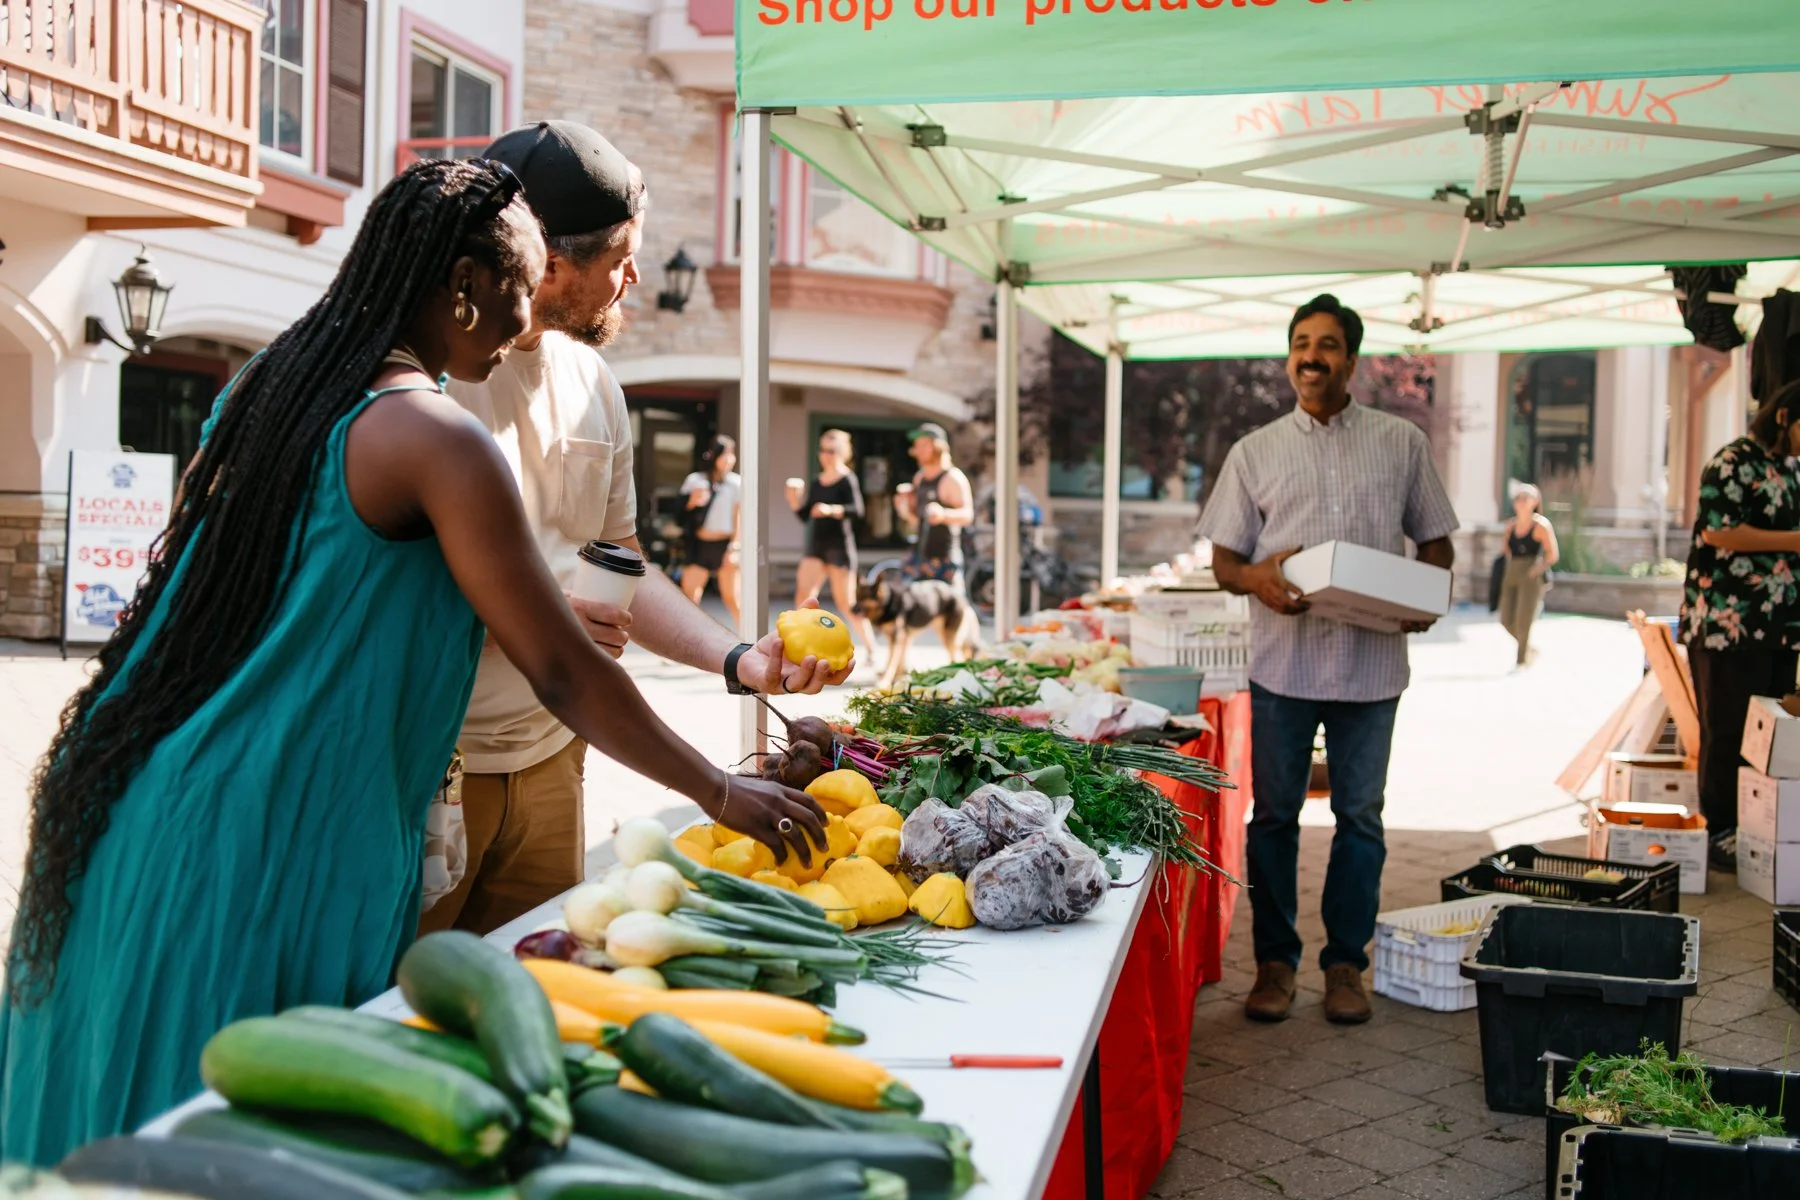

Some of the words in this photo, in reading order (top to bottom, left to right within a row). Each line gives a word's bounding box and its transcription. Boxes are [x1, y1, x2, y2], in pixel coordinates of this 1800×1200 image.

[757, 0, 893, 31] Shop
[913, 0, 996, 20] our
[78, 496, 163, 513] LOCALS
